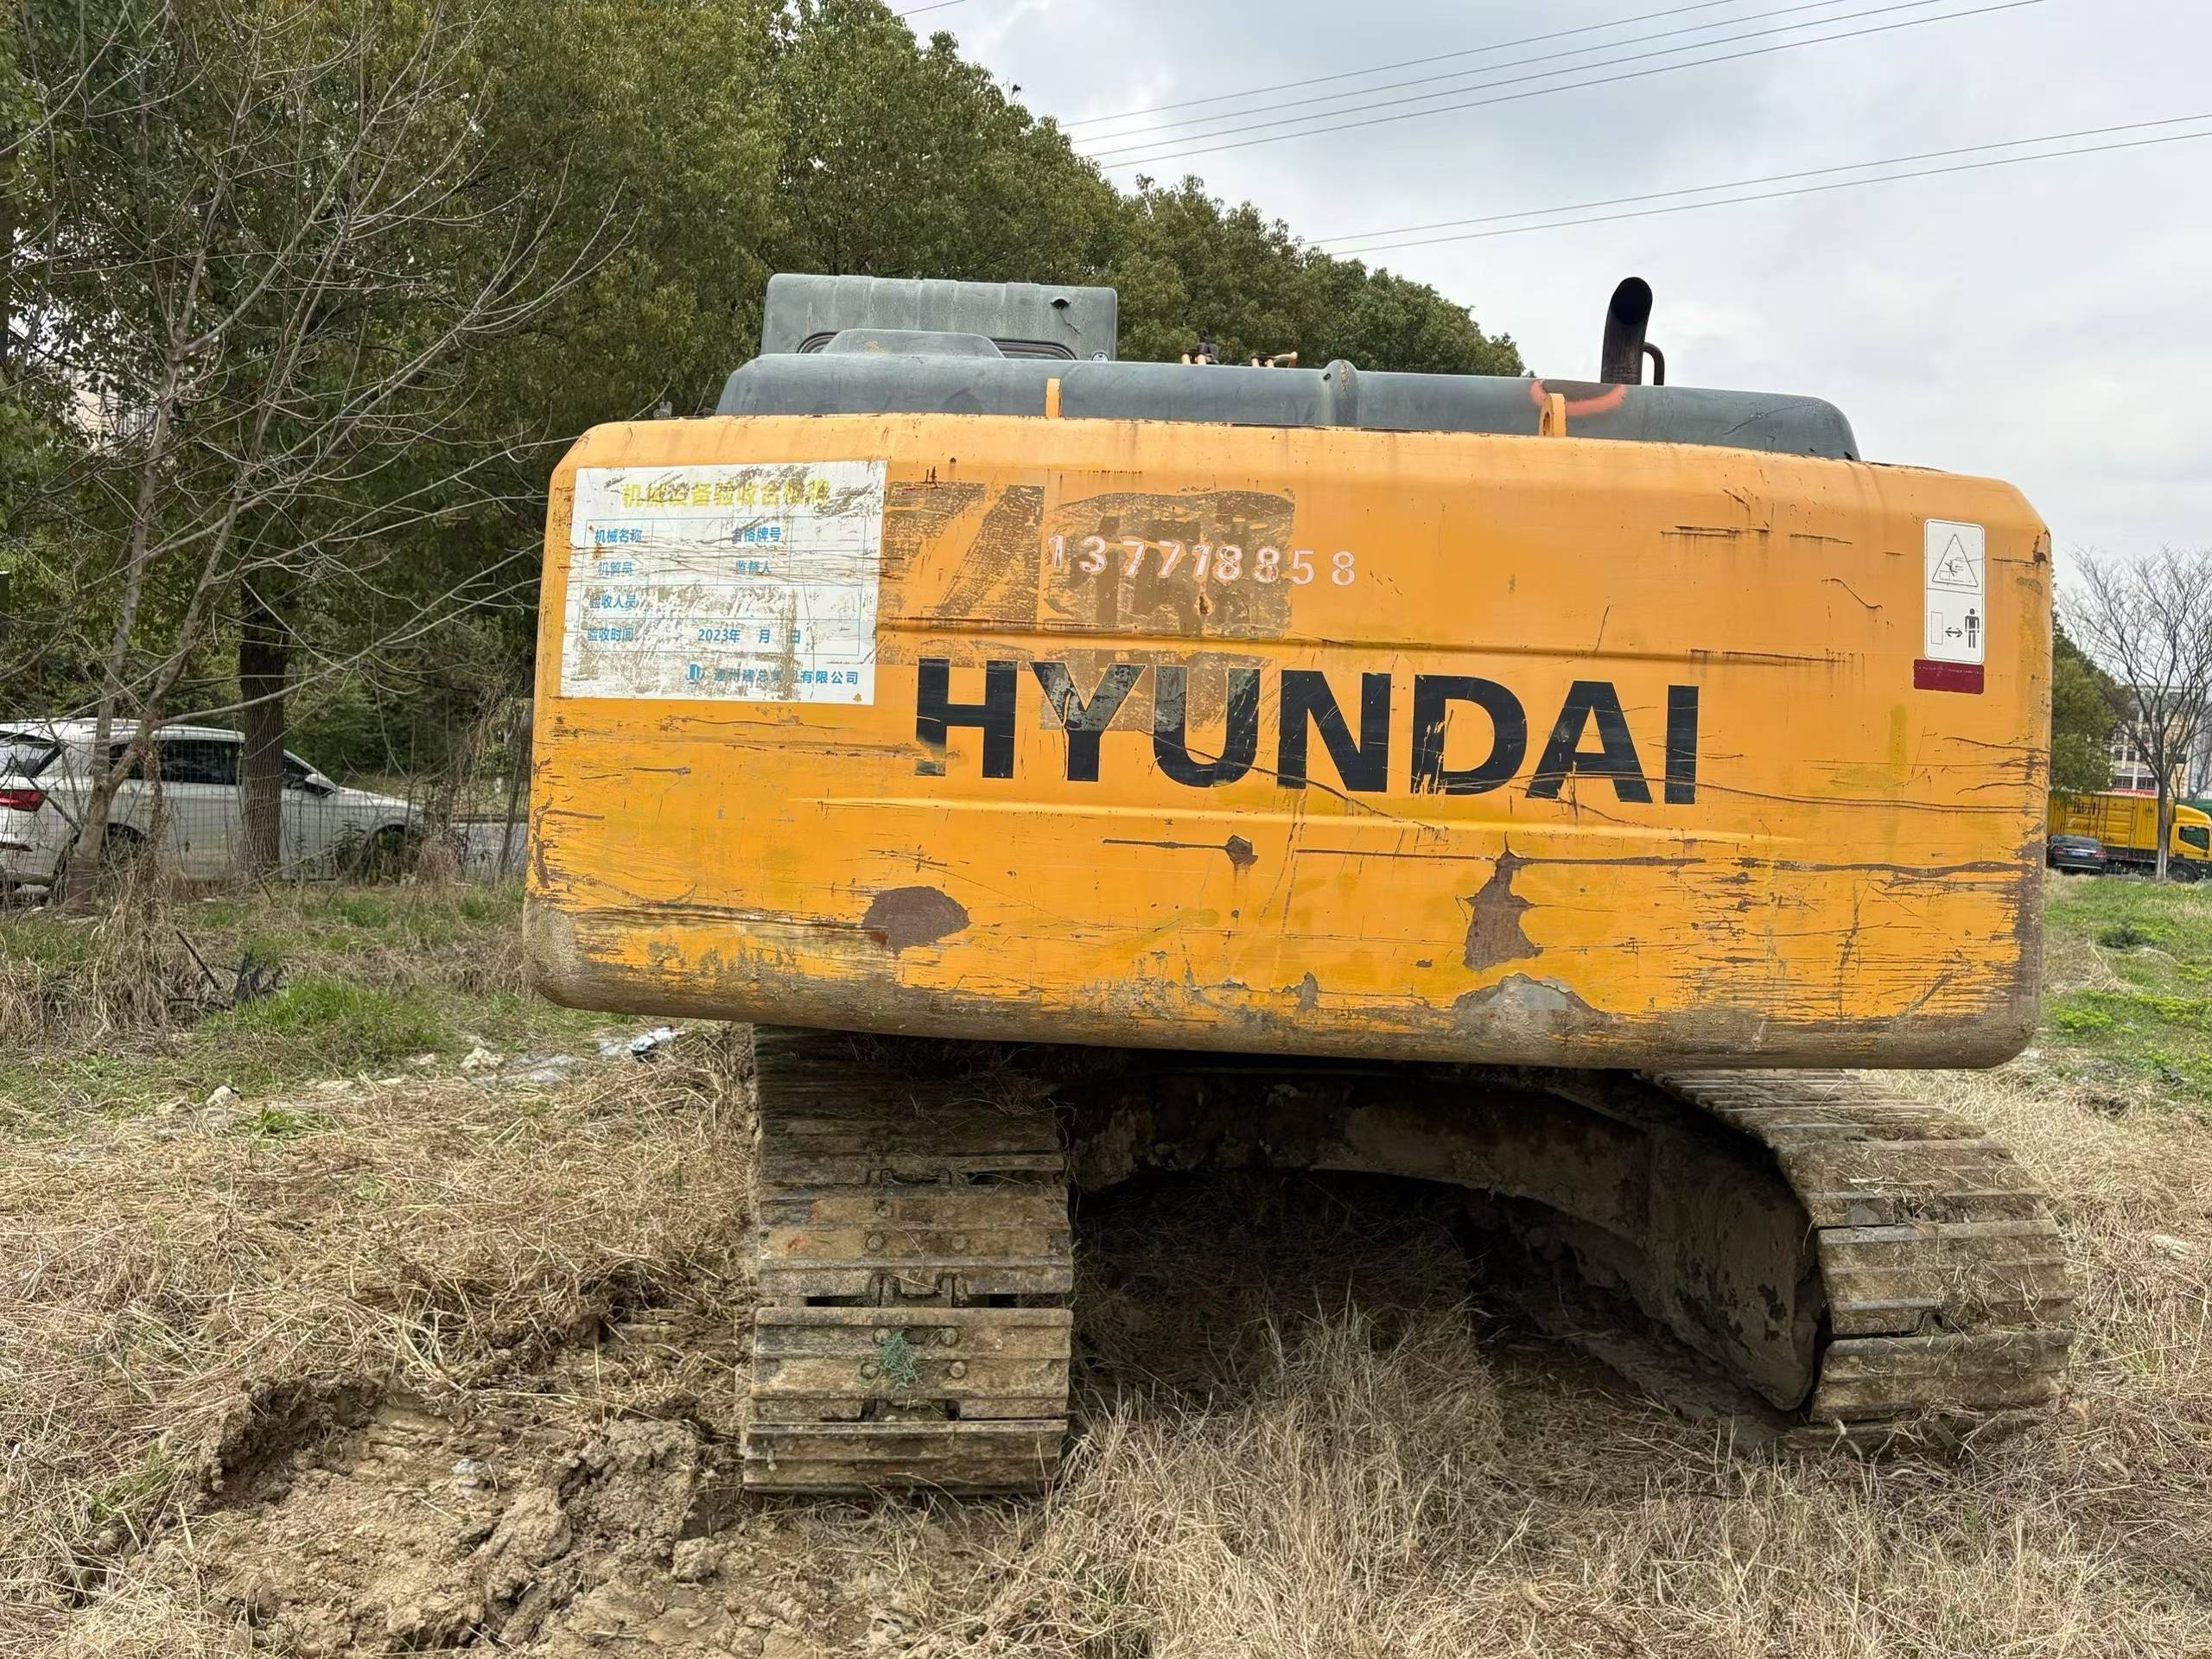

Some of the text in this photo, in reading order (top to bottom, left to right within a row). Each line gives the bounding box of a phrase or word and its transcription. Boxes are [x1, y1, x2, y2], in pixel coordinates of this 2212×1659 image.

[594, 528, 643, 543] 机械名称
[732, 527, 782, 543] 合格牌号
[589, 594, 638, 609] 验收人员
[586, 627, 633, 643] 验收时间
[698, 629, 802, 644] 2023年 月 日
[916, 657, 1700, 804] HYUNDAI
